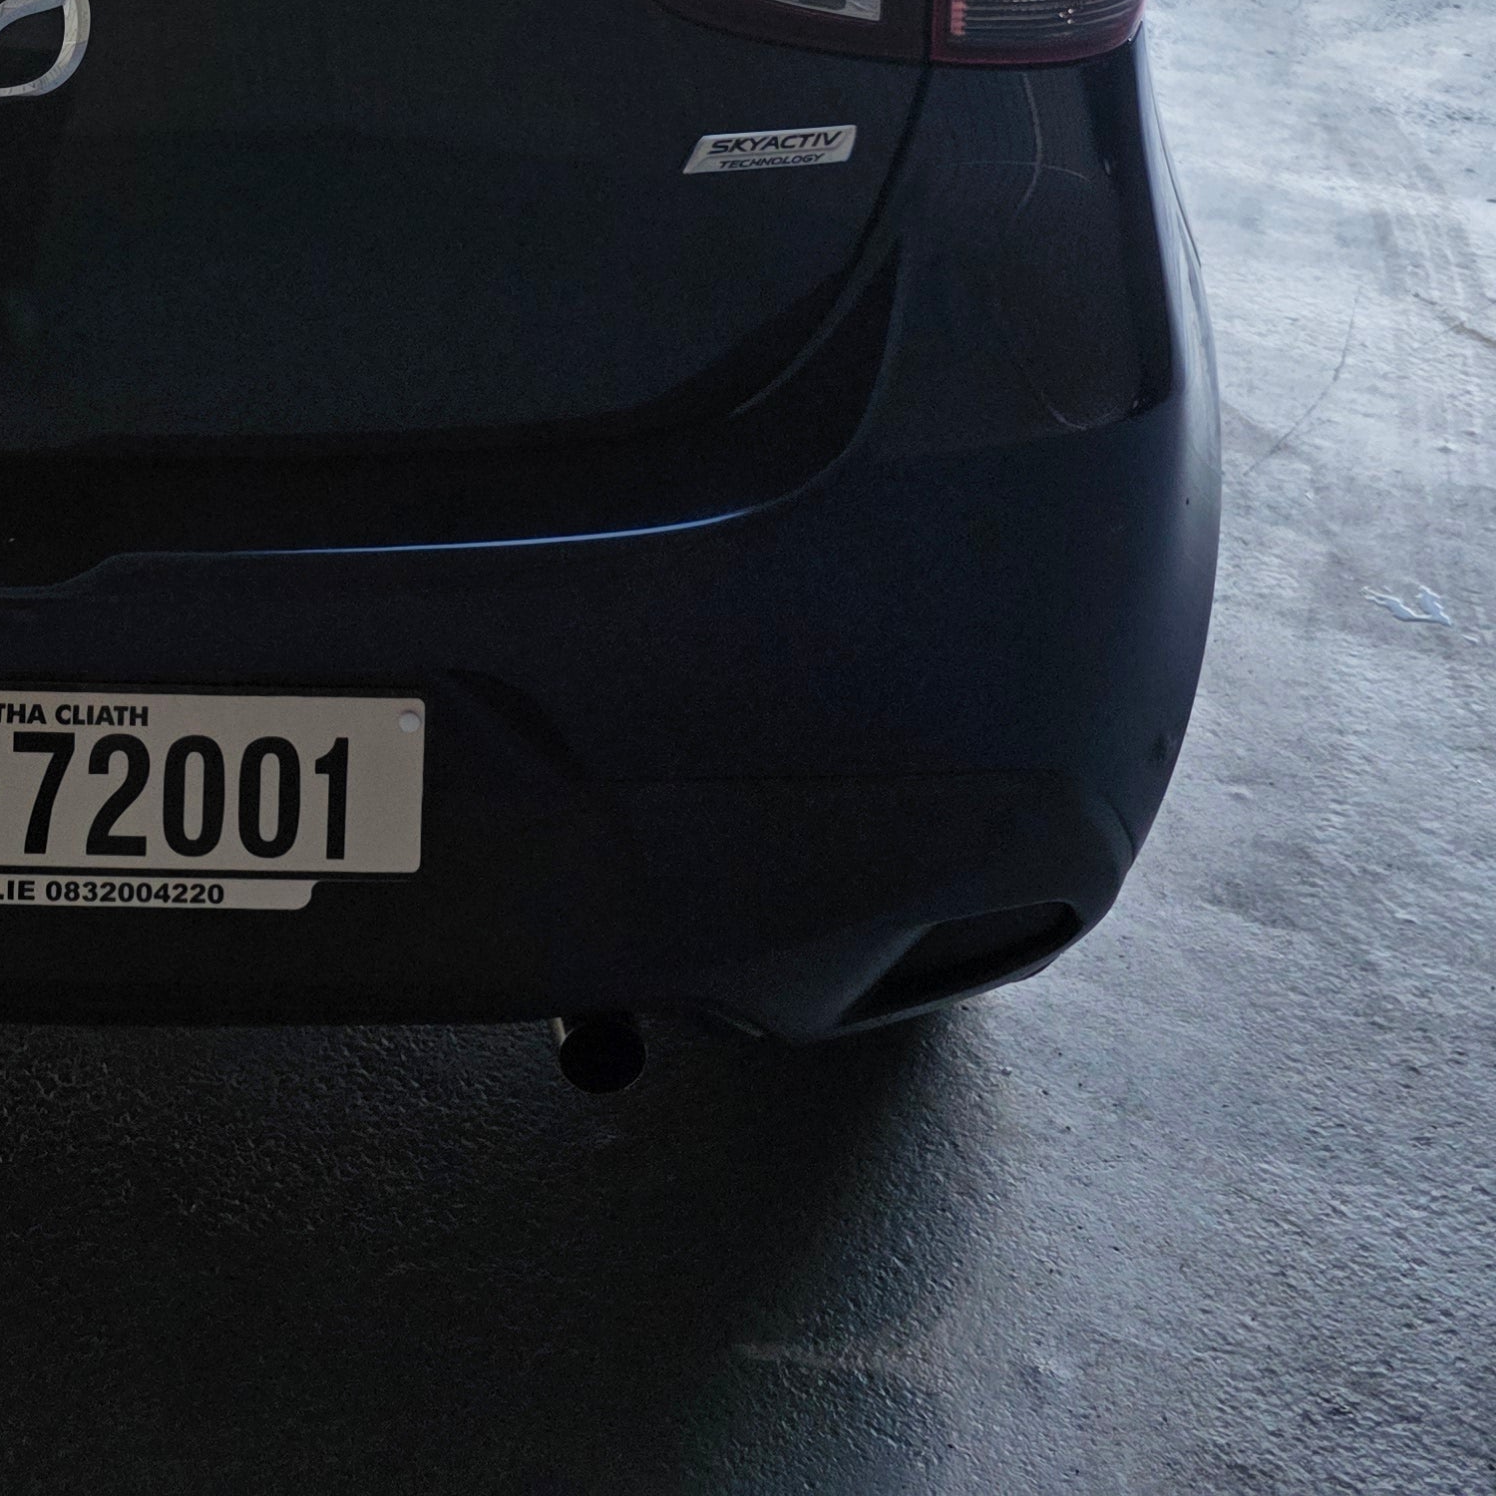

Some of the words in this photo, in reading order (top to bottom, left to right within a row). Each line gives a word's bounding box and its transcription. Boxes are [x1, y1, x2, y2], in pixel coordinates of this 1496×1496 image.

[708, 130, 843, 155] SKYACTIV
[718, 153, 826, 169] TECHNOLOGY
[54, 703, 149, 727] CLIATH
[45, 880, 225, 905] 0832004220
